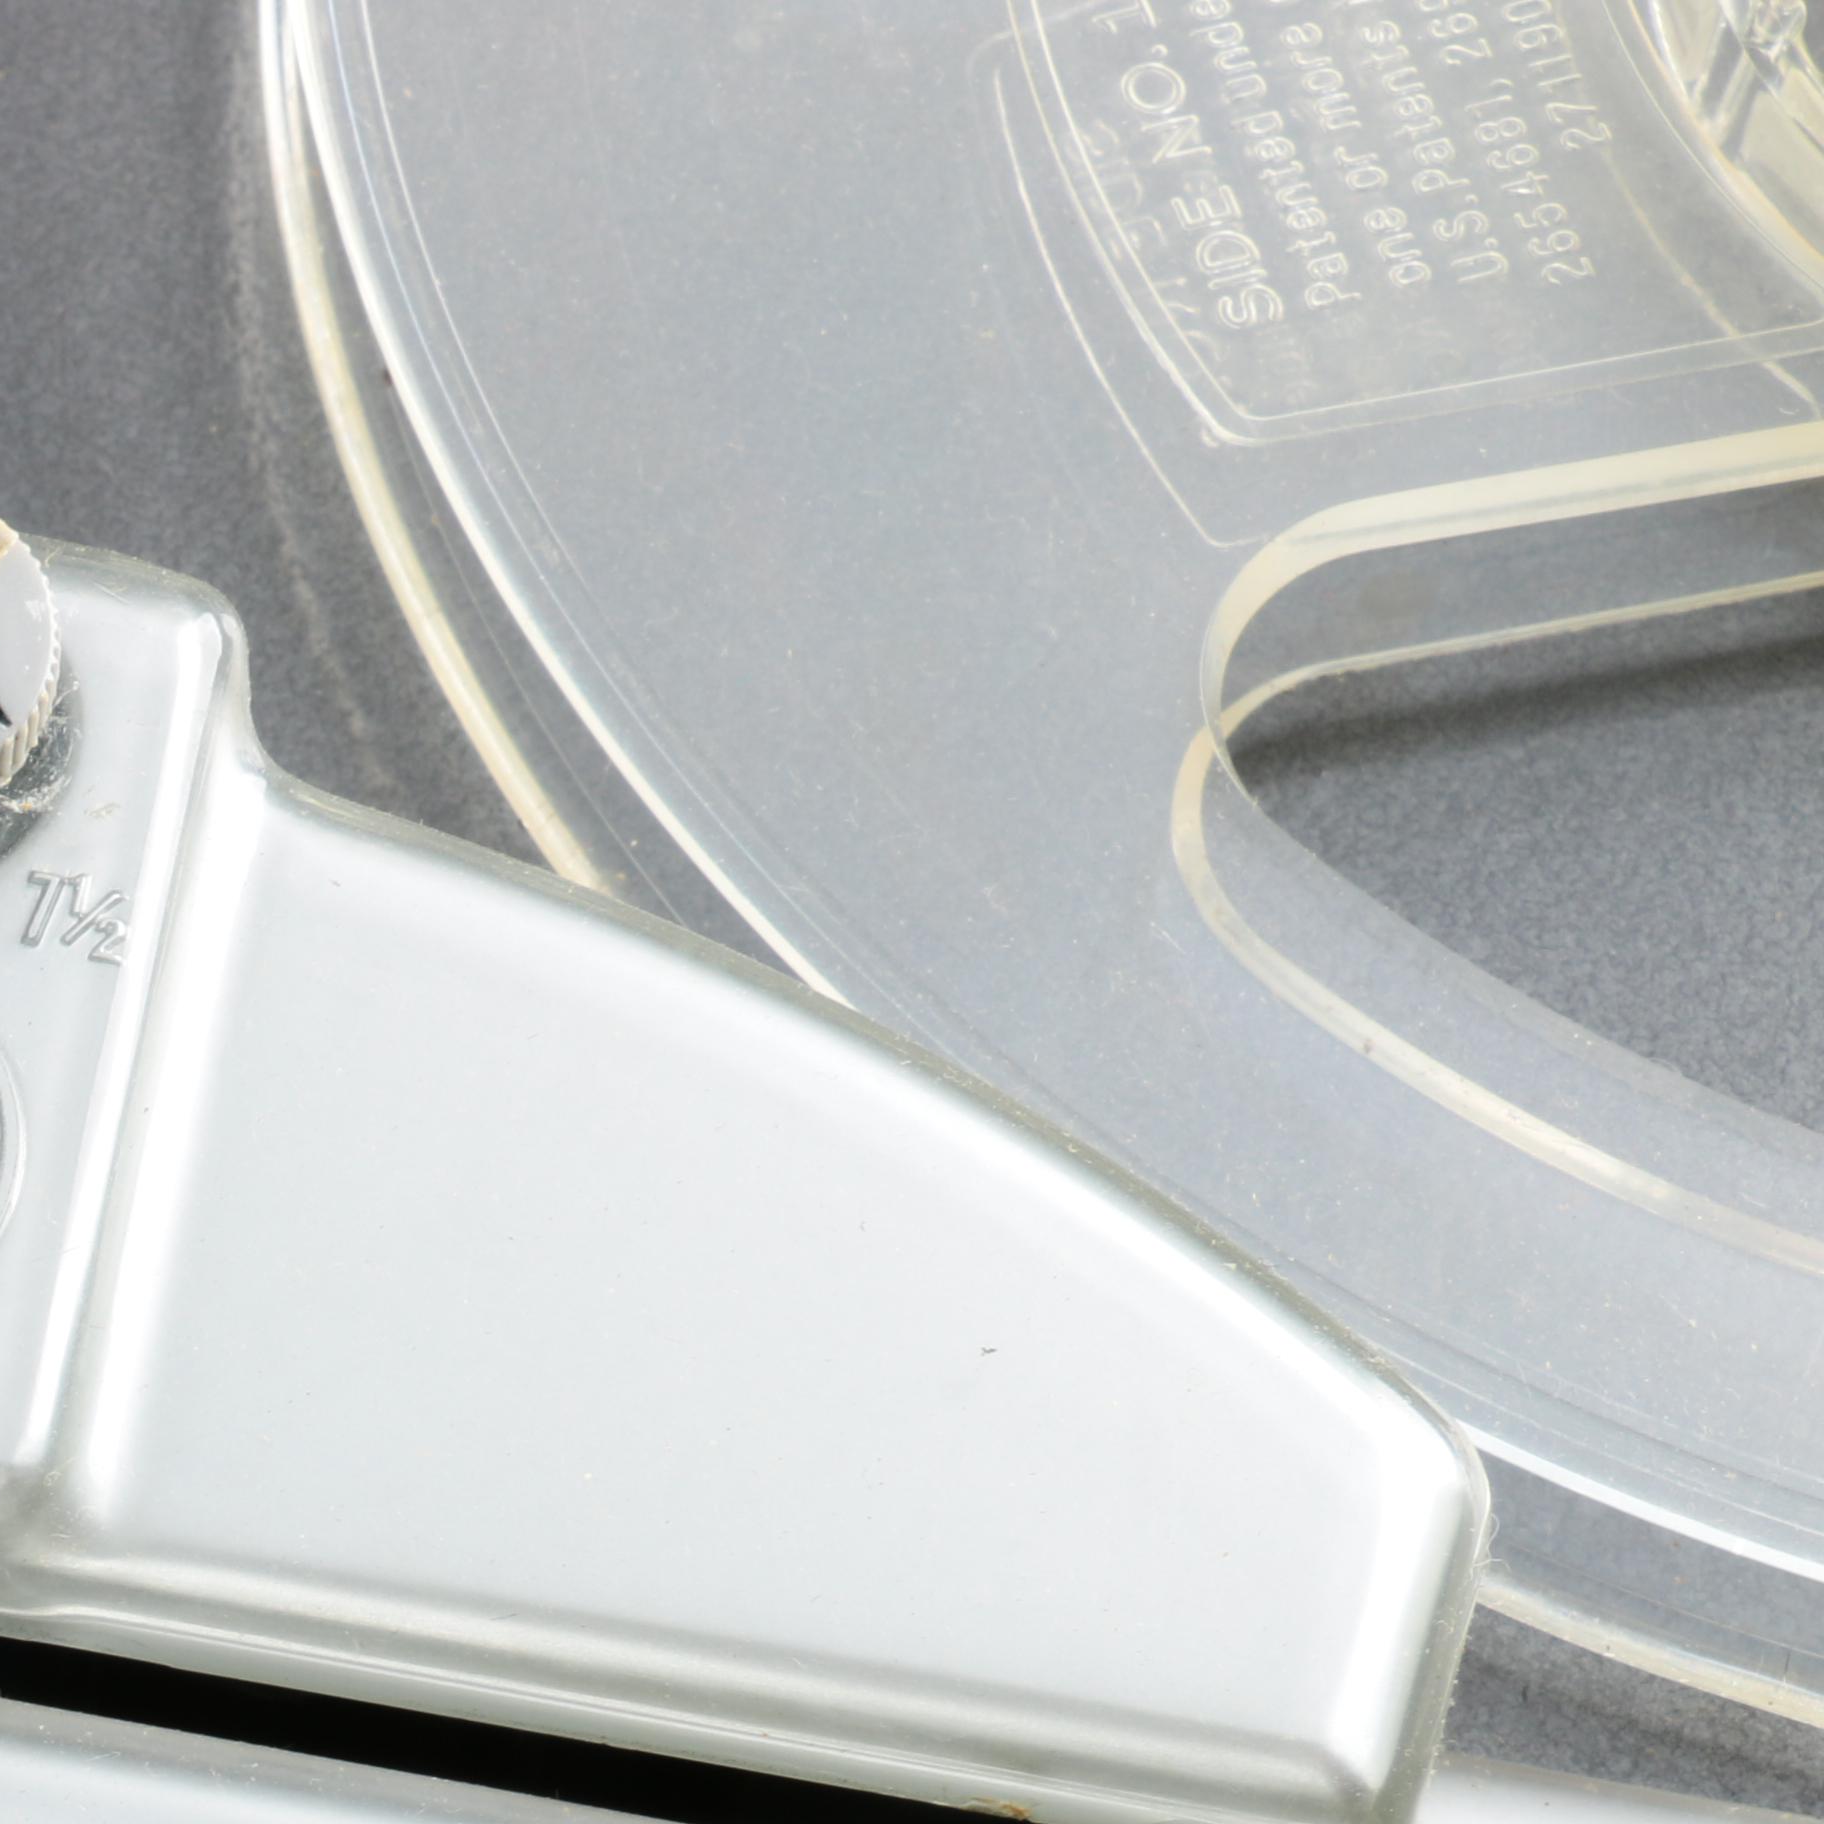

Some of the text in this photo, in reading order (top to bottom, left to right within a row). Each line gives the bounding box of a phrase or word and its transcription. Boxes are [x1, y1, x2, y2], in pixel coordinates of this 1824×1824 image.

[1121, 43, 1213, 164] NO.
[1280, 21, 1431, 288] one or more
[1171, 185, 1284, 328] SIDE
[1232, 110, 1360, 310] Patented
